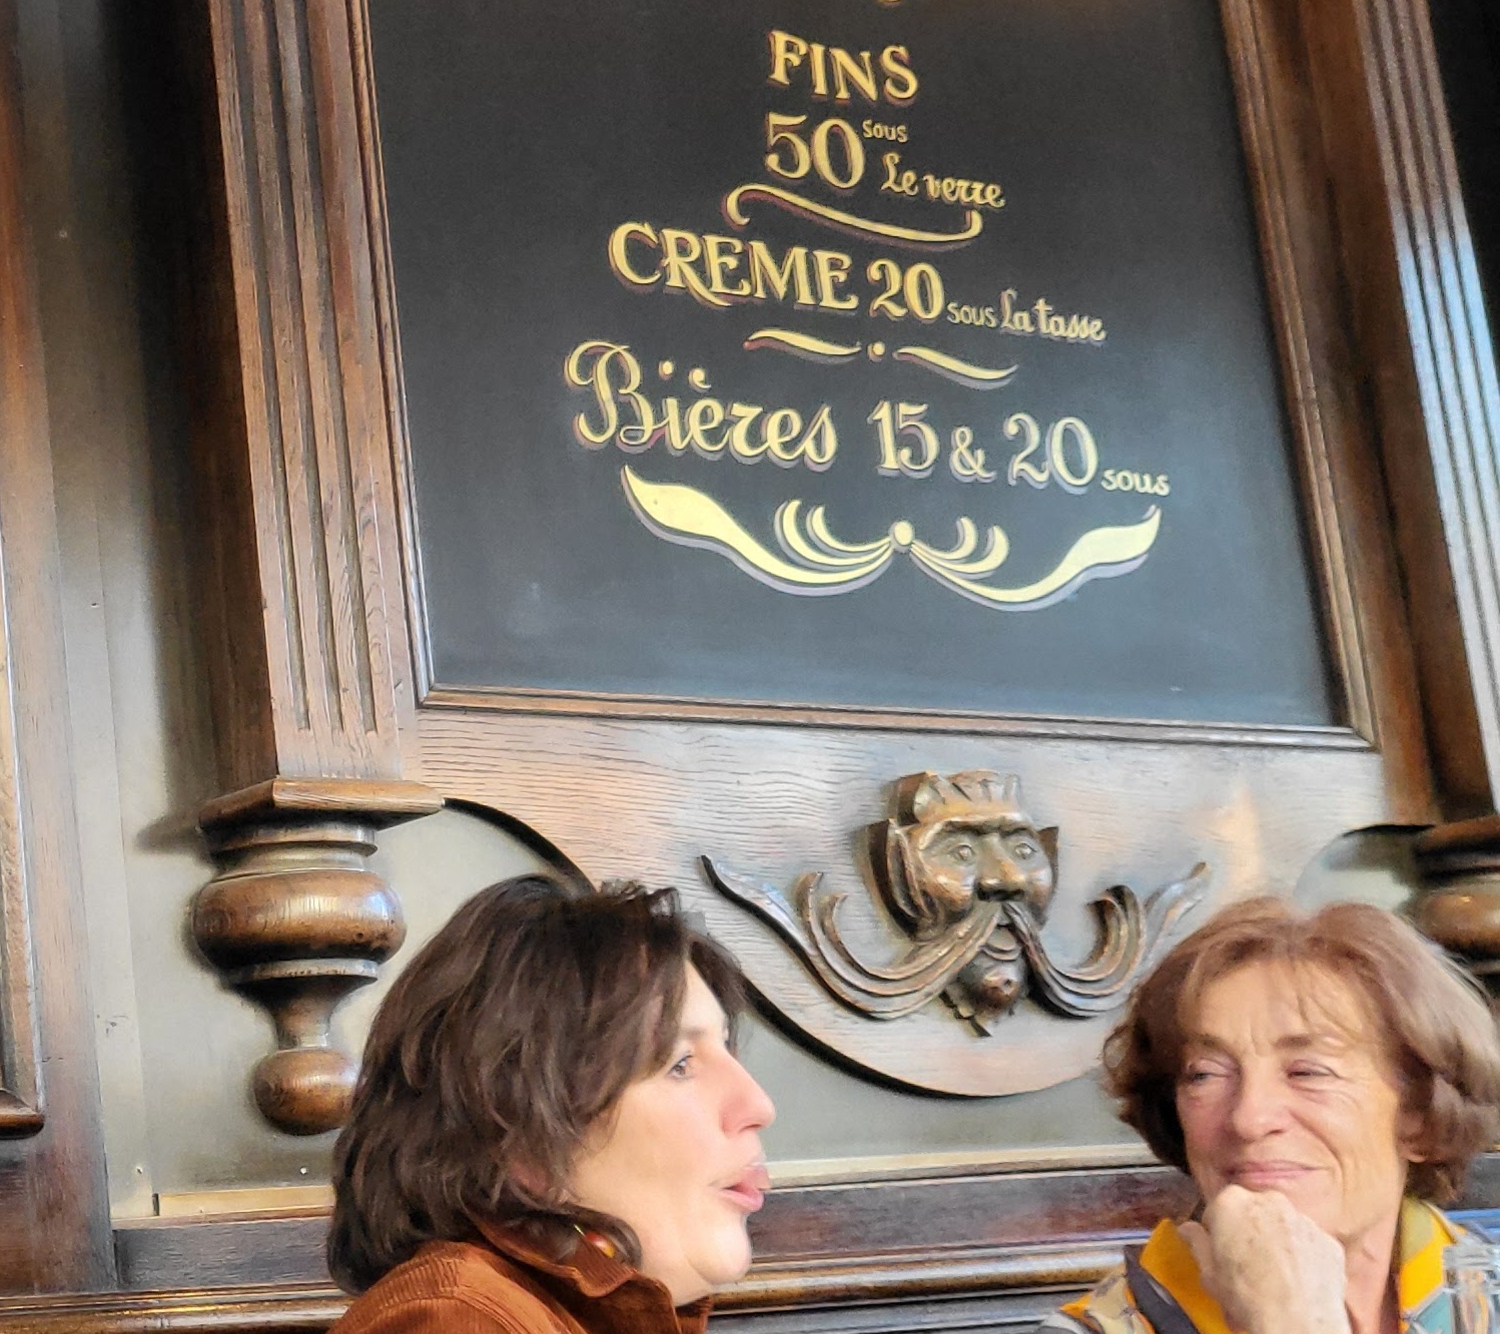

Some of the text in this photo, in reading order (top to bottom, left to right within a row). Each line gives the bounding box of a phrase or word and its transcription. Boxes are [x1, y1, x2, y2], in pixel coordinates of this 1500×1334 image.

[766, 30, 919, 104] FINS
[765, 112, 866, 193] 50
[880, 152, 1006, 208] Le verre
[607, 222, 860, 315] CREME
[867, 257, 944, 322] 20
[947, 300, 997, 329] sous
[1036, 298, 1107, 342] tasse
[565, 339, 1172, 497] Bières 15 & 20 sous
